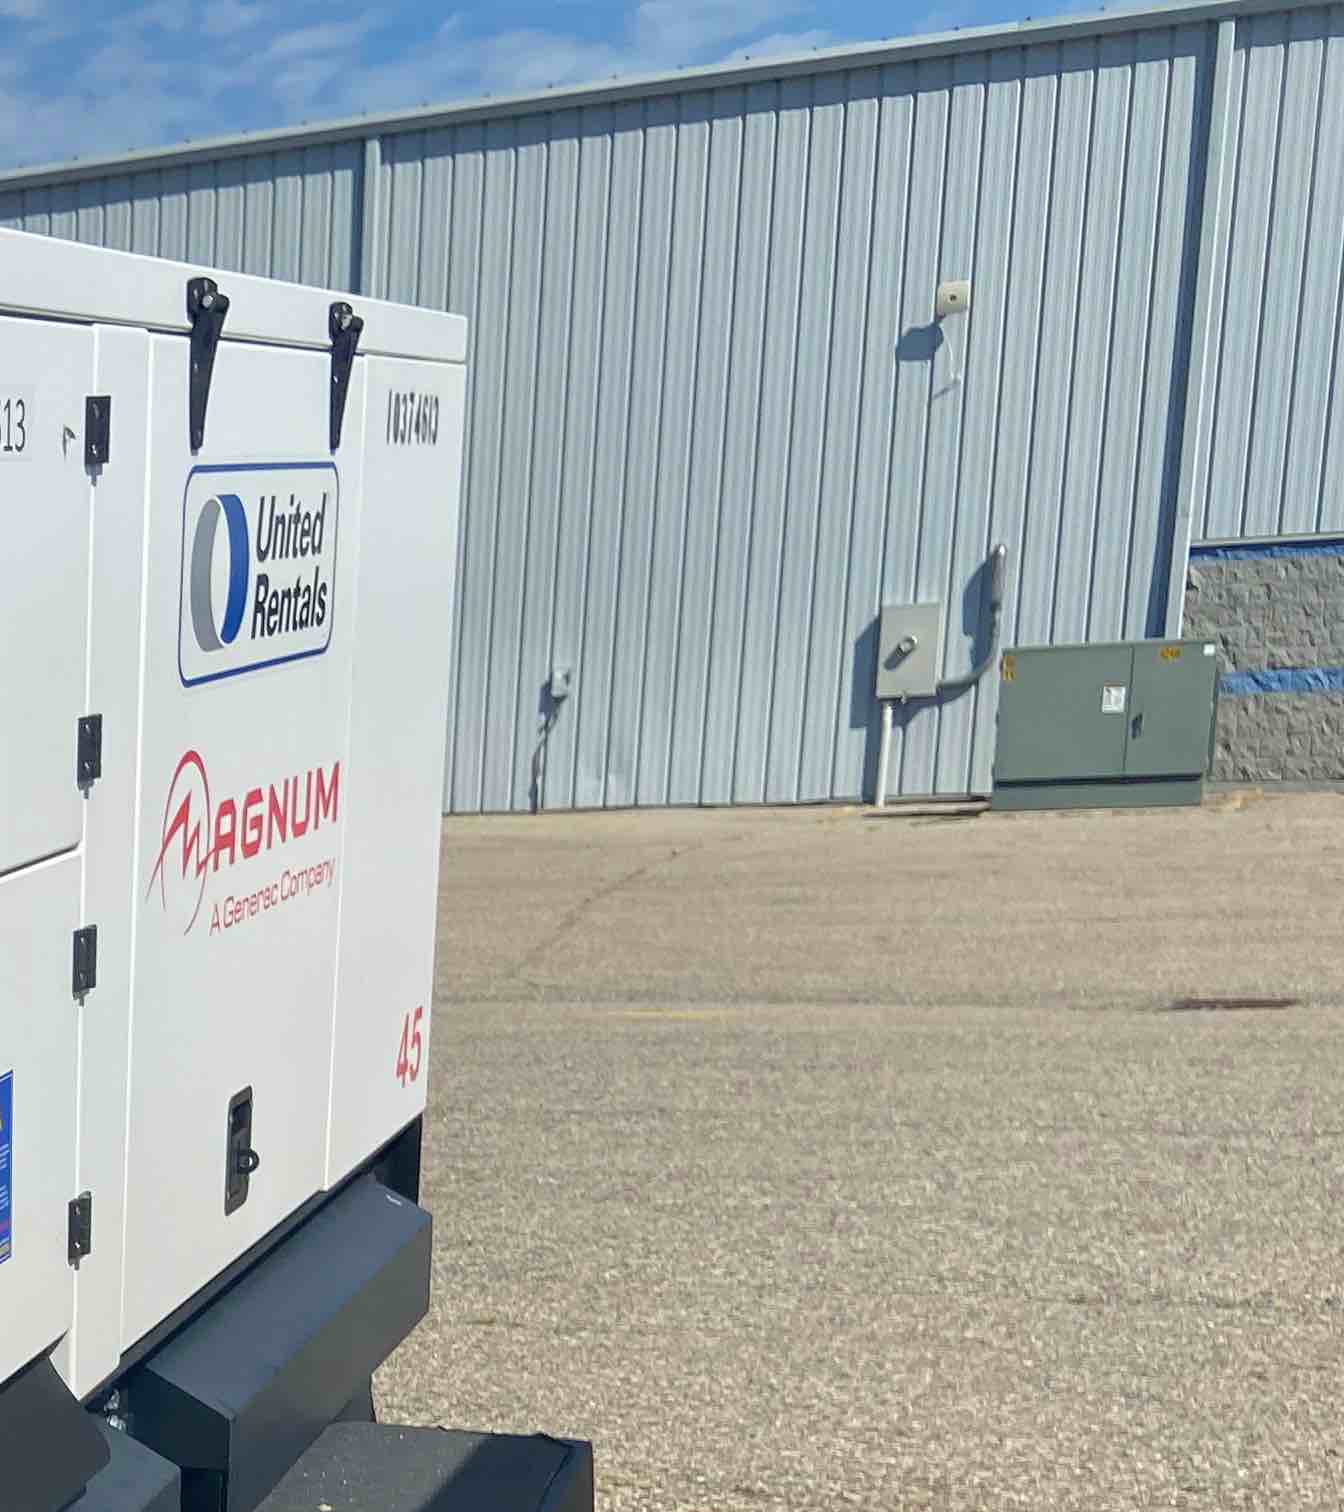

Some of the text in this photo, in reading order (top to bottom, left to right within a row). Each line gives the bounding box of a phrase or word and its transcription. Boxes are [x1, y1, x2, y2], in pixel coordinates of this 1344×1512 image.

[386, 388, 439, 446] 10374613
[256, 492, 327, 563] United
[251, 565, 328, 641] Rentals
[146, 752, 340, 905] MAGNUM
[209, 857, 336, 937] A Generac Company
[395, 1004, 423, 1089] 45
